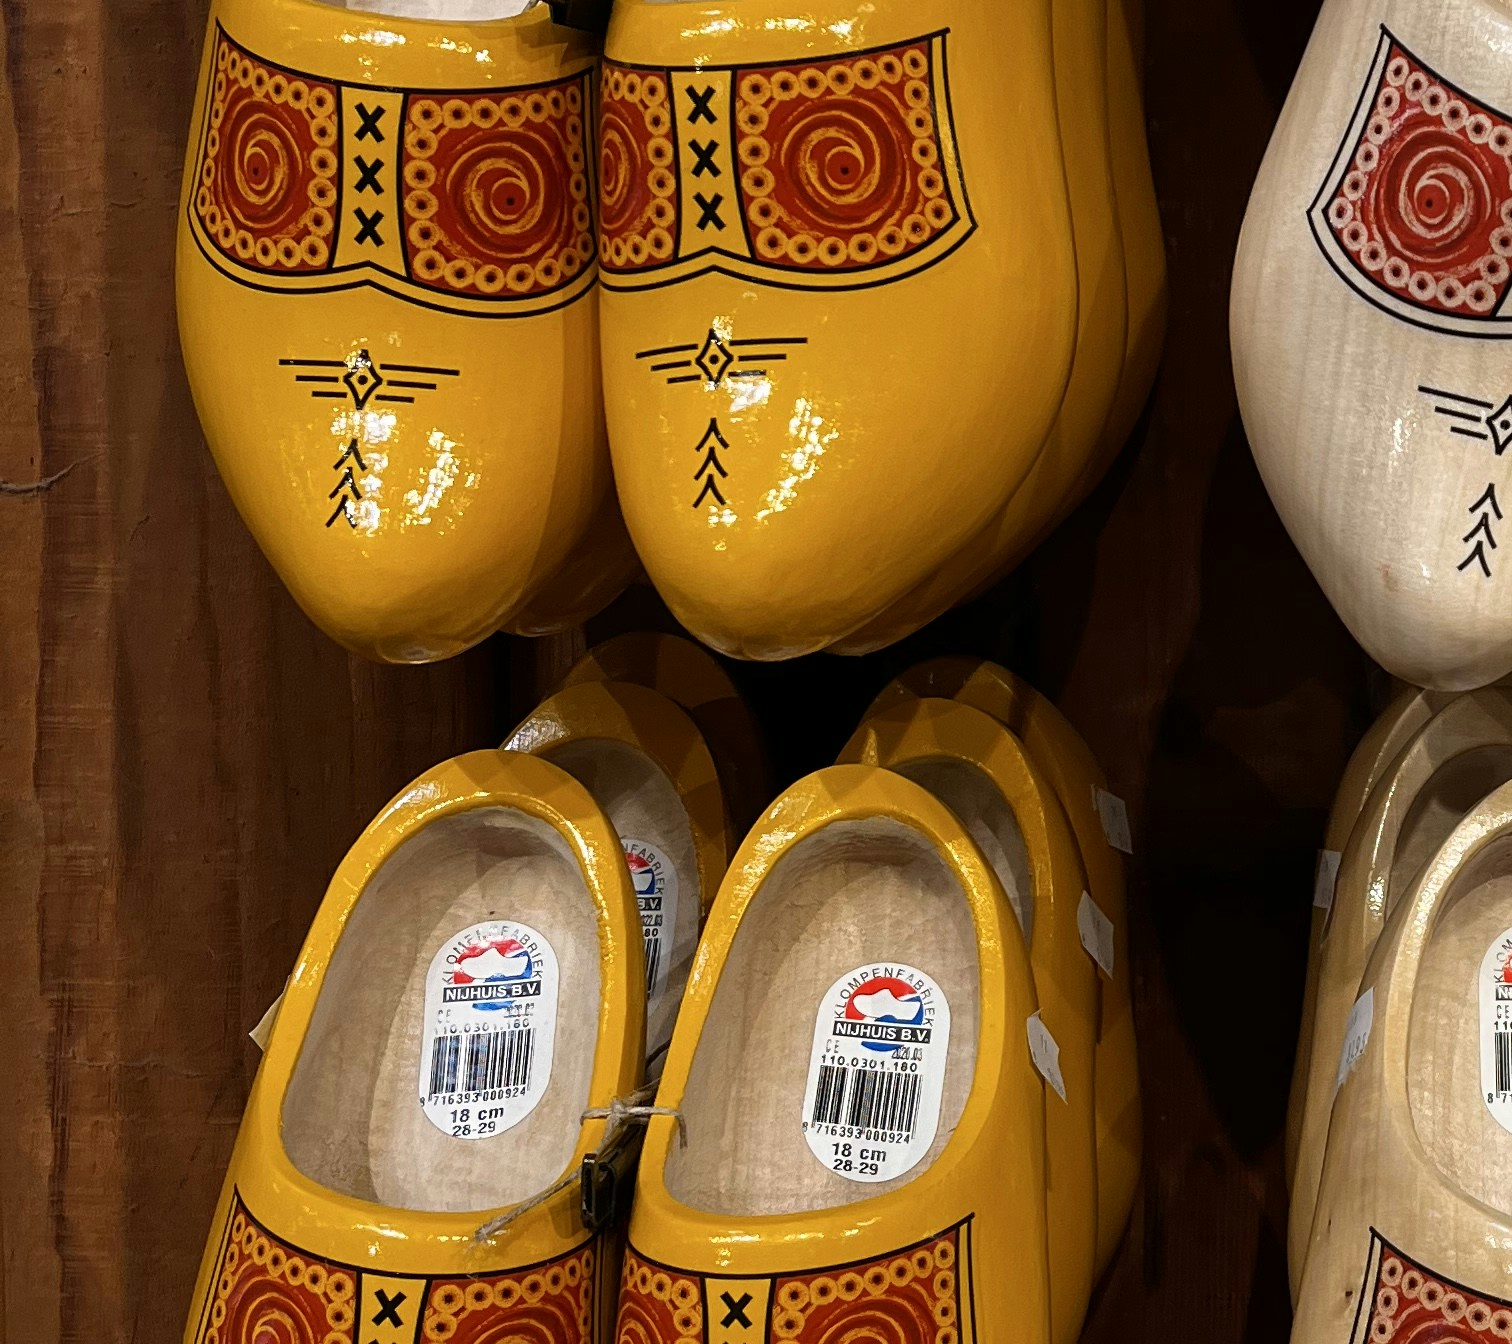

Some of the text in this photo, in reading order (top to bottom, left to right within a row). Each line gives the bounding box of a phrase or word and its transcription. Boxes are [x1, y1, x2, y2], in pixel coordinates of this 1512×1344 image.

[446, 983, 540, 1001] NIJHUIS B.V.
[834, 968, 933, 1027] KLOMPENFABRIEK
[837, 1023, 928, 1043] NIJHUIS B.V.
[821, 1055, 917, 1072] 110.0301.180
[450, 1108, 504, 1122] 18 cm
[453, 1122, 495, 1137] 28-29
[832, 1142, 886, 1162] 18 cm
[833, 1159, 878, 1175] 28-29
